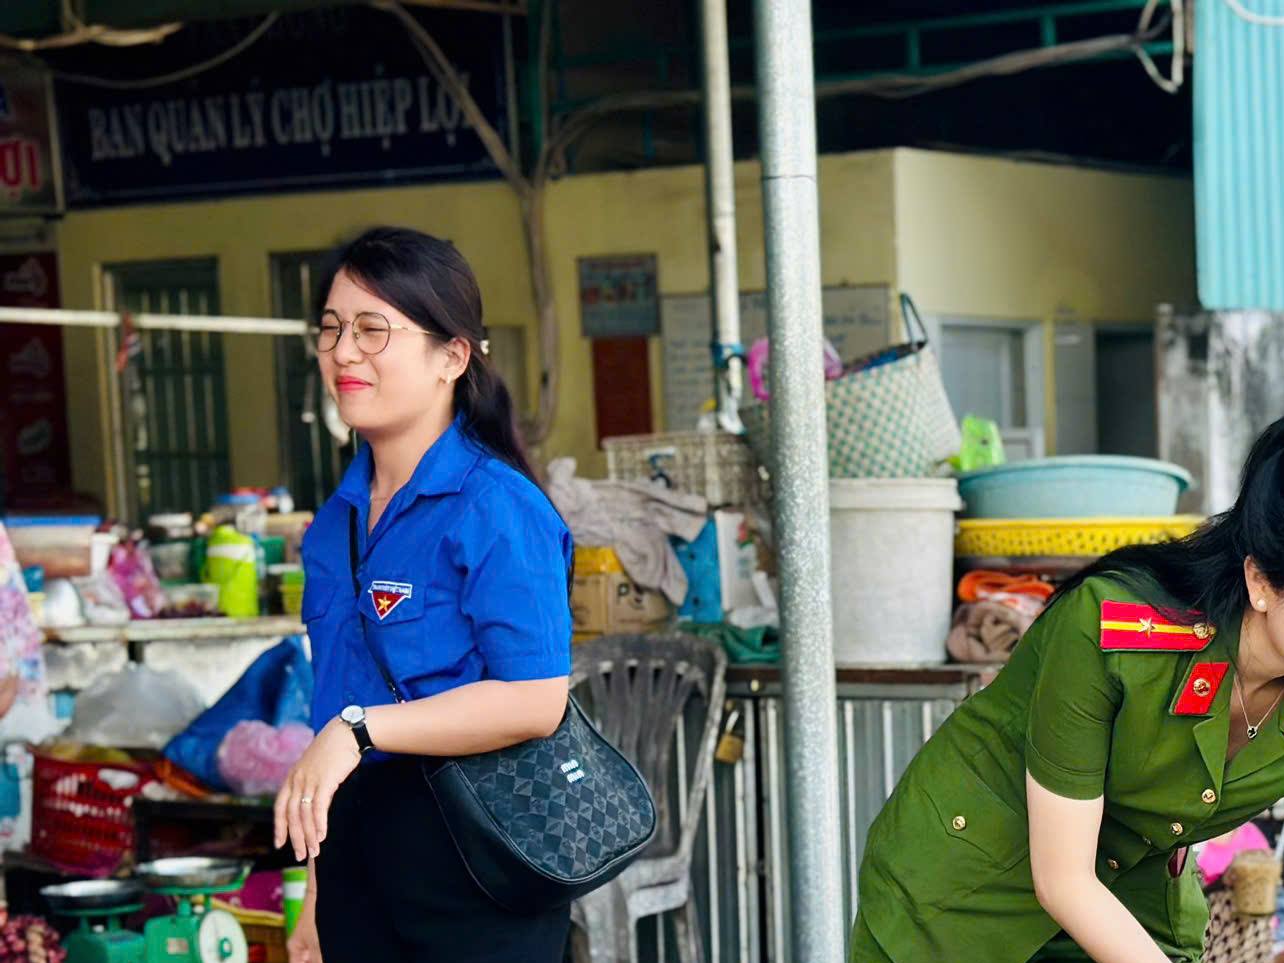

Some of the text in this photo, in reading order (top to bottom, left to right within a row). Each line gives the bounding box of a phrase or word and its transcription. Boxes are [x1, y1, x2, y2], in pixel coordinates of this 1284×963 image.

[88, 106, 147, 161] BAN
[228, 79, 269, 149] LÝ
[271, 81, 335, 156] CHỢ
[338, 63, 413, 150] HIỆP
